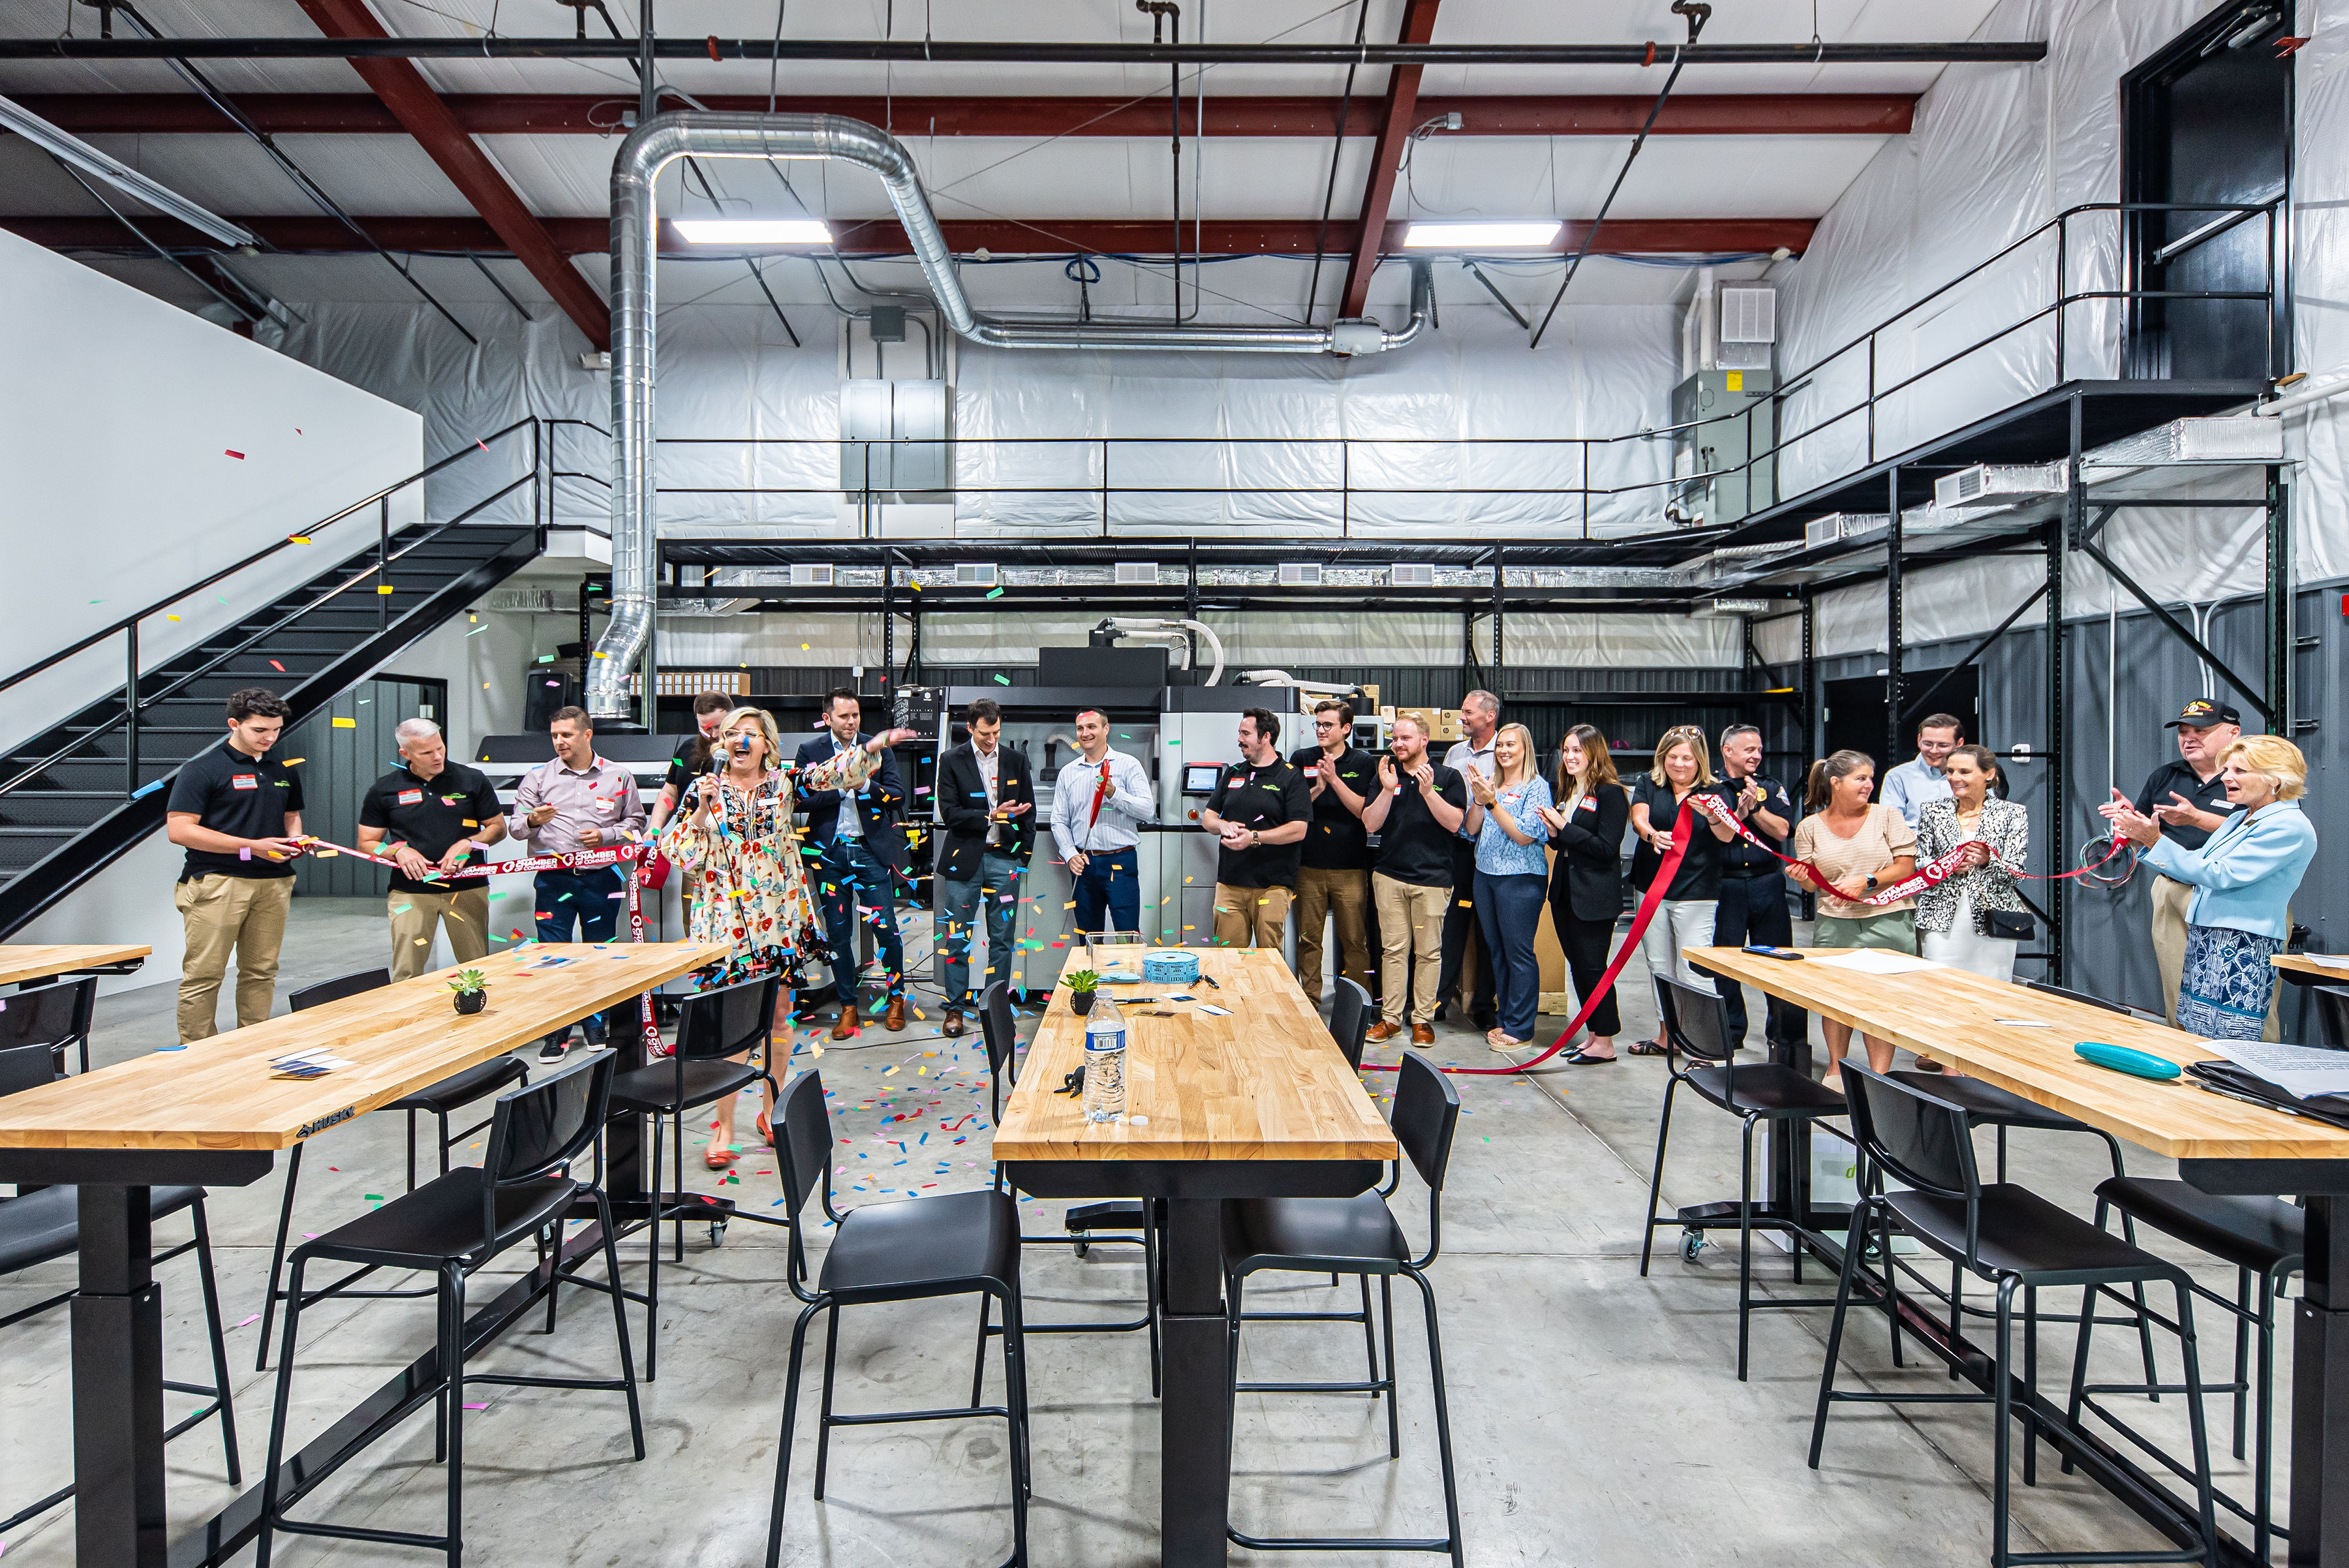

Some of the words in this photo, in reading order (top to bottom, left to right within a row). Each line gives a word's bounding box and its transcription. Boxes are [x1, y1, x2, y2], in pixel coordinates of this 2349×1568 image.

[1710, 797, 1741, 833] CHAMBER
[515, 857, 557, 868] CHAMBER
[575, 850, 616, 861] CHAMBER
[584, 856, 617, 865] COMMERCE
[1941, 849, 1963, 869] CHAM
[1877, 876, 1925, 902] CHAMBER
[1890, 882, 1929, 901] COMMERCE
[313, 1105, 356, 1132] HUSKY
